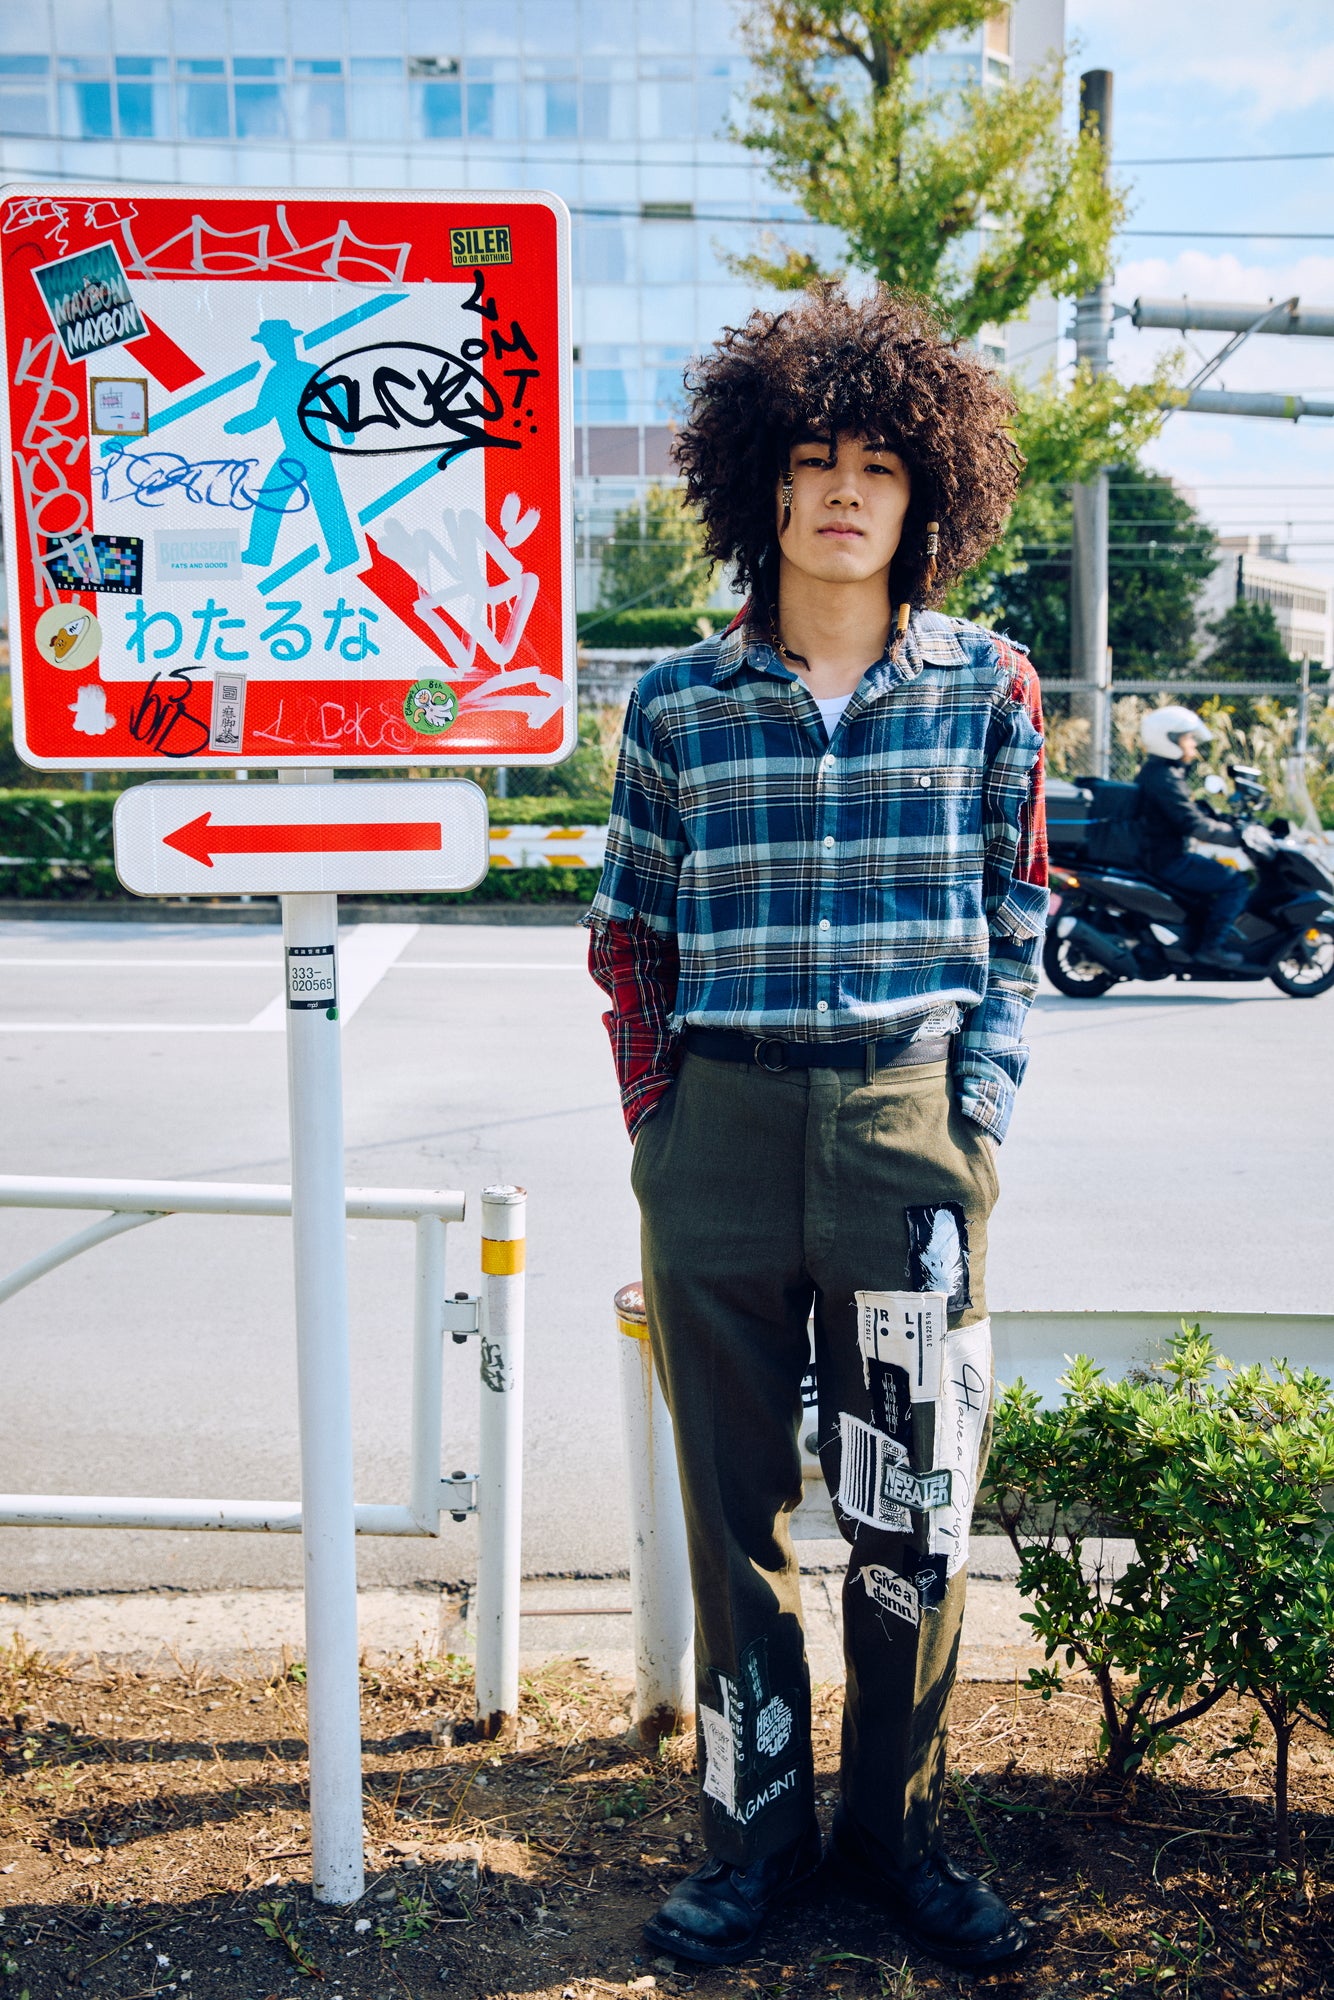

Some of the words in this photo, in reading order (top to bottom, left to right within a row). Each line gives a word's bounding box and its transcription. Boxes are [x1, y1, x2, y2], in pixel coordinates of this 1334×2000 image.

[452, 229, 509, 255] SILER
[454, 255, 468, 264] 100
[469, 254, 479, 263] OR
[480, 253, 510, 262] NOTHING
[54, 273, 126, 327] MAXBON
[66, 301, 139, 355] MAXBON
[159, 540, 239, 565] BACKSEAT
[80, 582, 138, 594] pixelated
[124, 597, 382, 664] わたるな
[291, 966, 322, 980] 333-
[291, 977, 333, 992] 020565
[879, 1308, 889, 1322] R
[905, 1312, 914, 1325] L
[925, 1311, 932, 1319] 18
[925, 1325, 932, 1334] 22
[926, 1334, 932, 1342] 15
[950, 1363, 985, 1440] Have
[956, 1446, 963, 1462] a
[869, 1569, 903, 1597] Give
[903, 1589, 912, 1604] a
[872, 1585, 916, 1621] damn.
